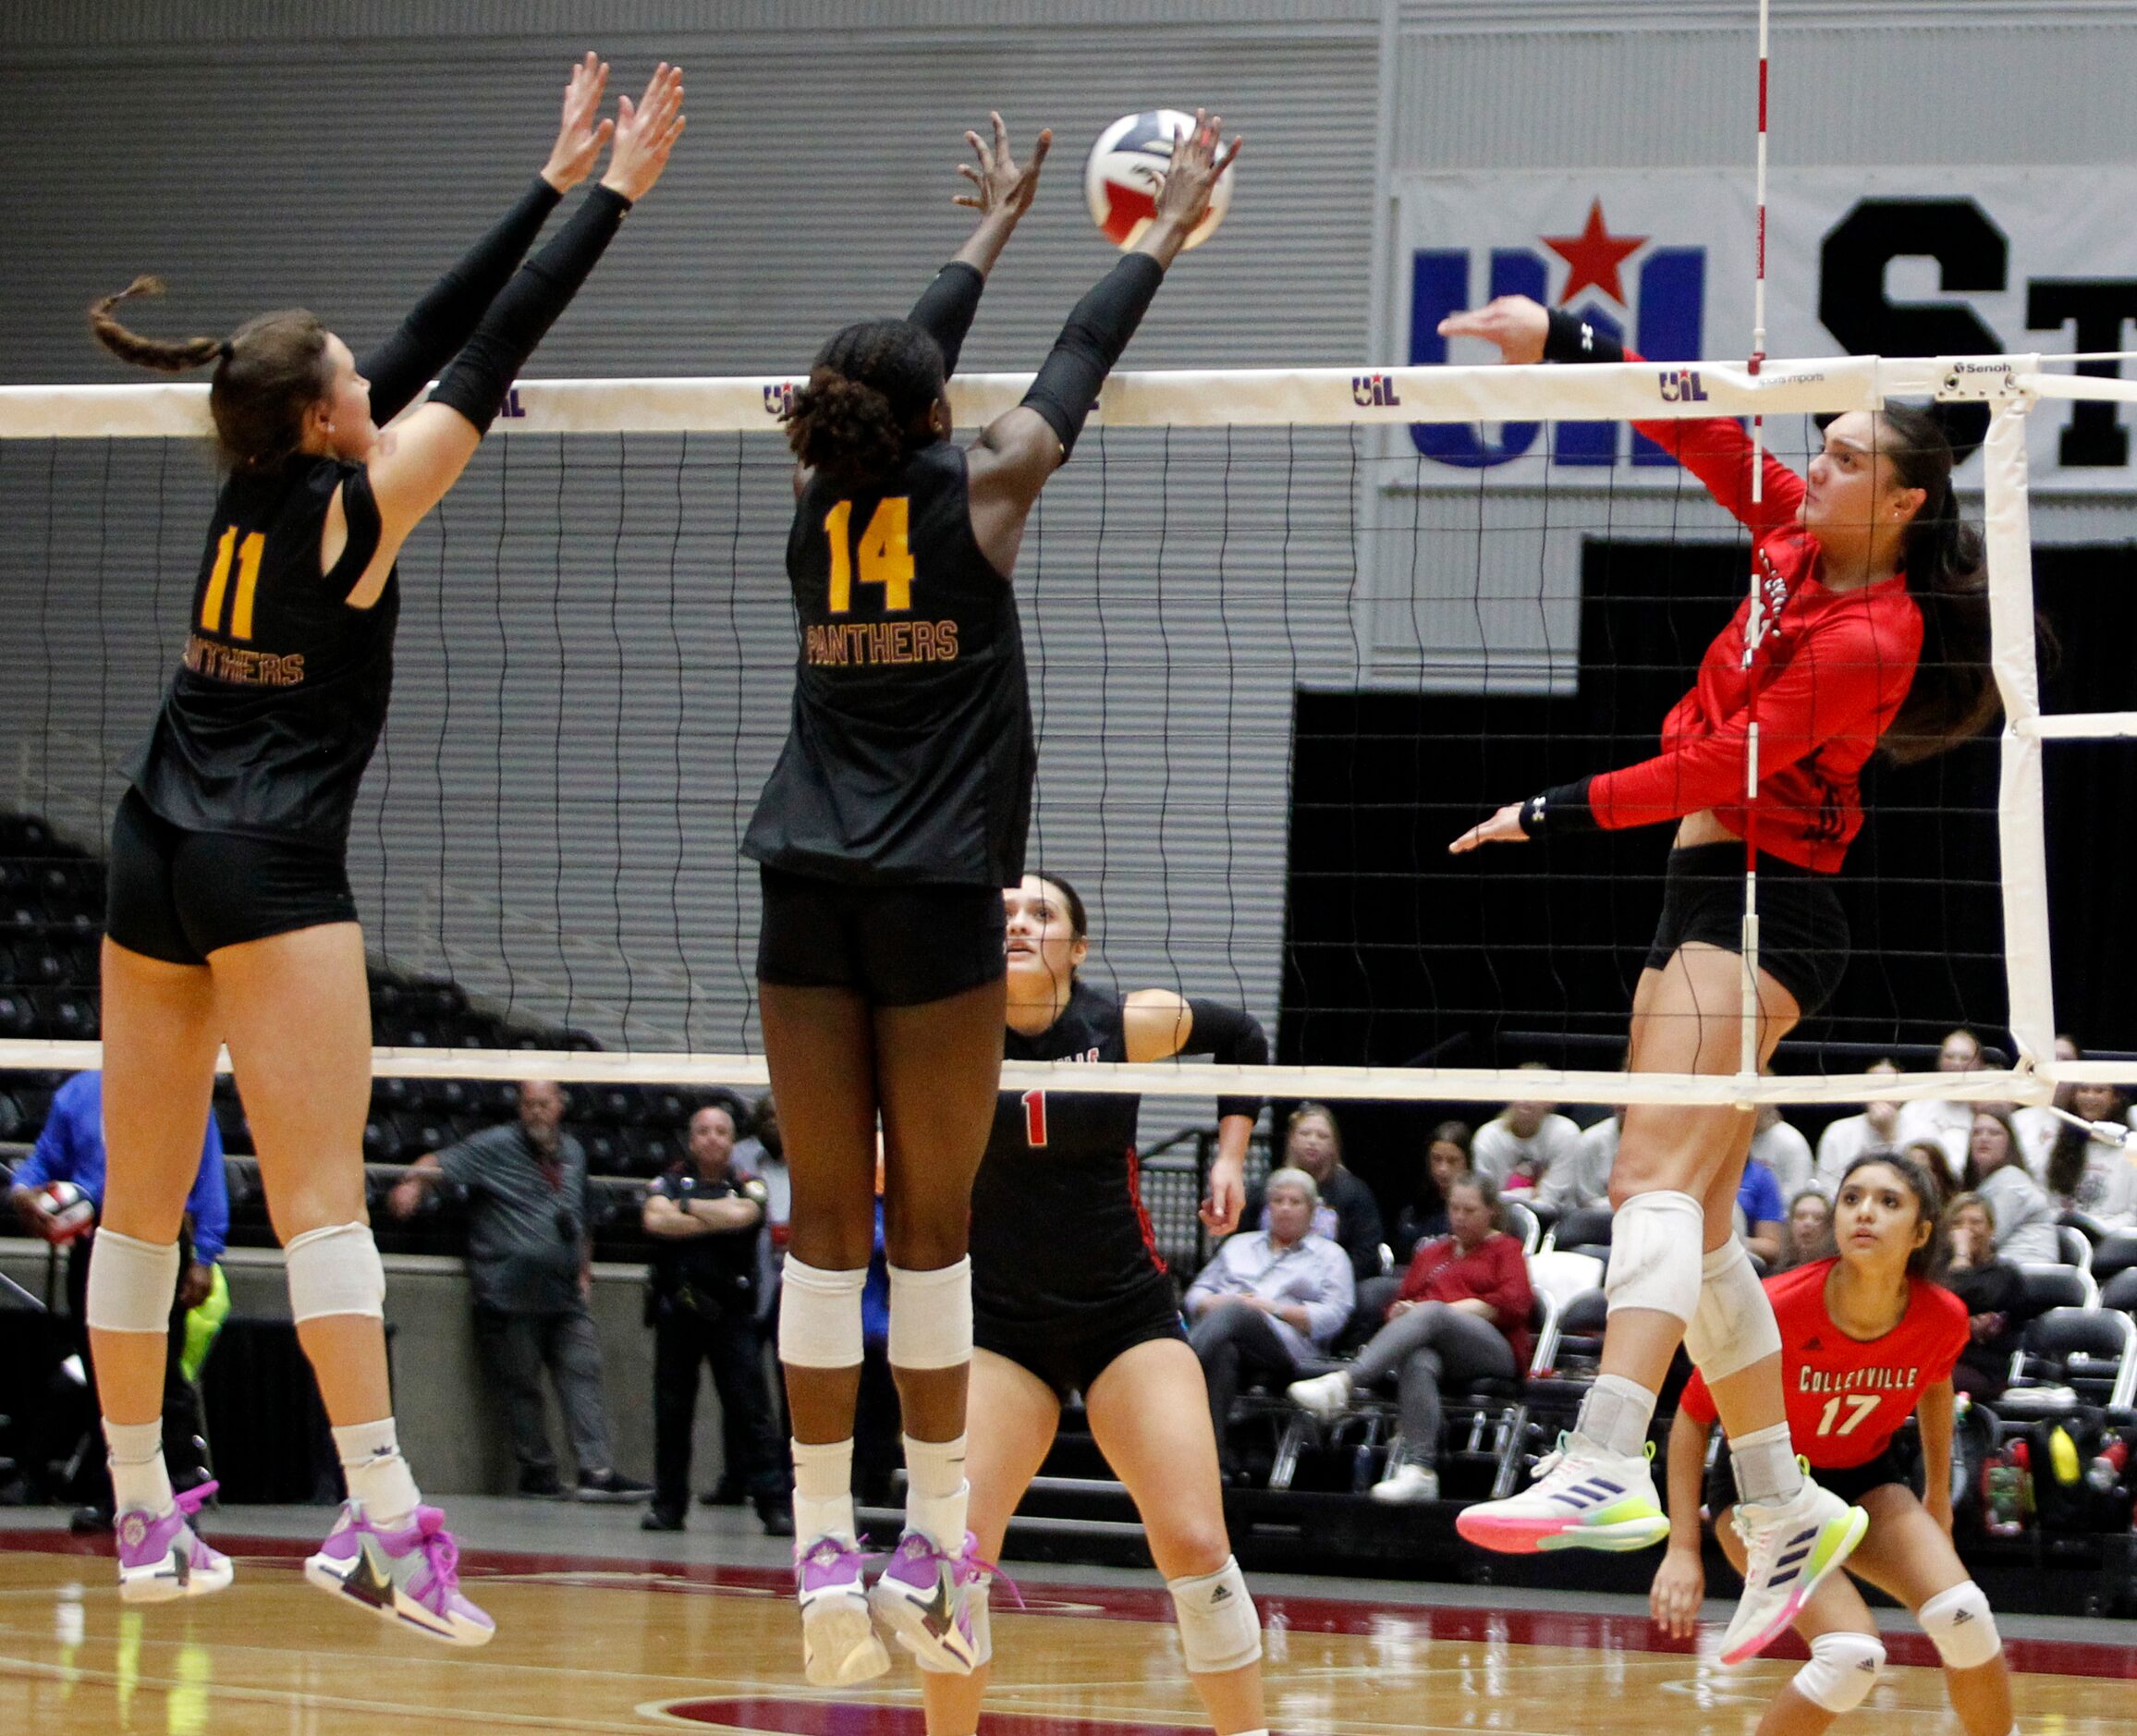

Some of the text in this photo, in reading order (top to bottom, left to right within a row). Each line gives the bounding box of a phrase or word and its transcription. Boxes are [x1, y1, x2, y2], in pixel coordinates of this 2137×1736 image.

[1788, 372, 1825, 383] imports
[1966, 362, 2012, 373] Senoh
[763, 380, 806, 415] UI
[824, 495, 916, 612] 14
[201, 524, 266, 640] 11
[806, 619, 959, 665] PANTHERS
[1021, 1088, 1047, 1147] 1
[1816, 1394, 1882, 1437] 17
